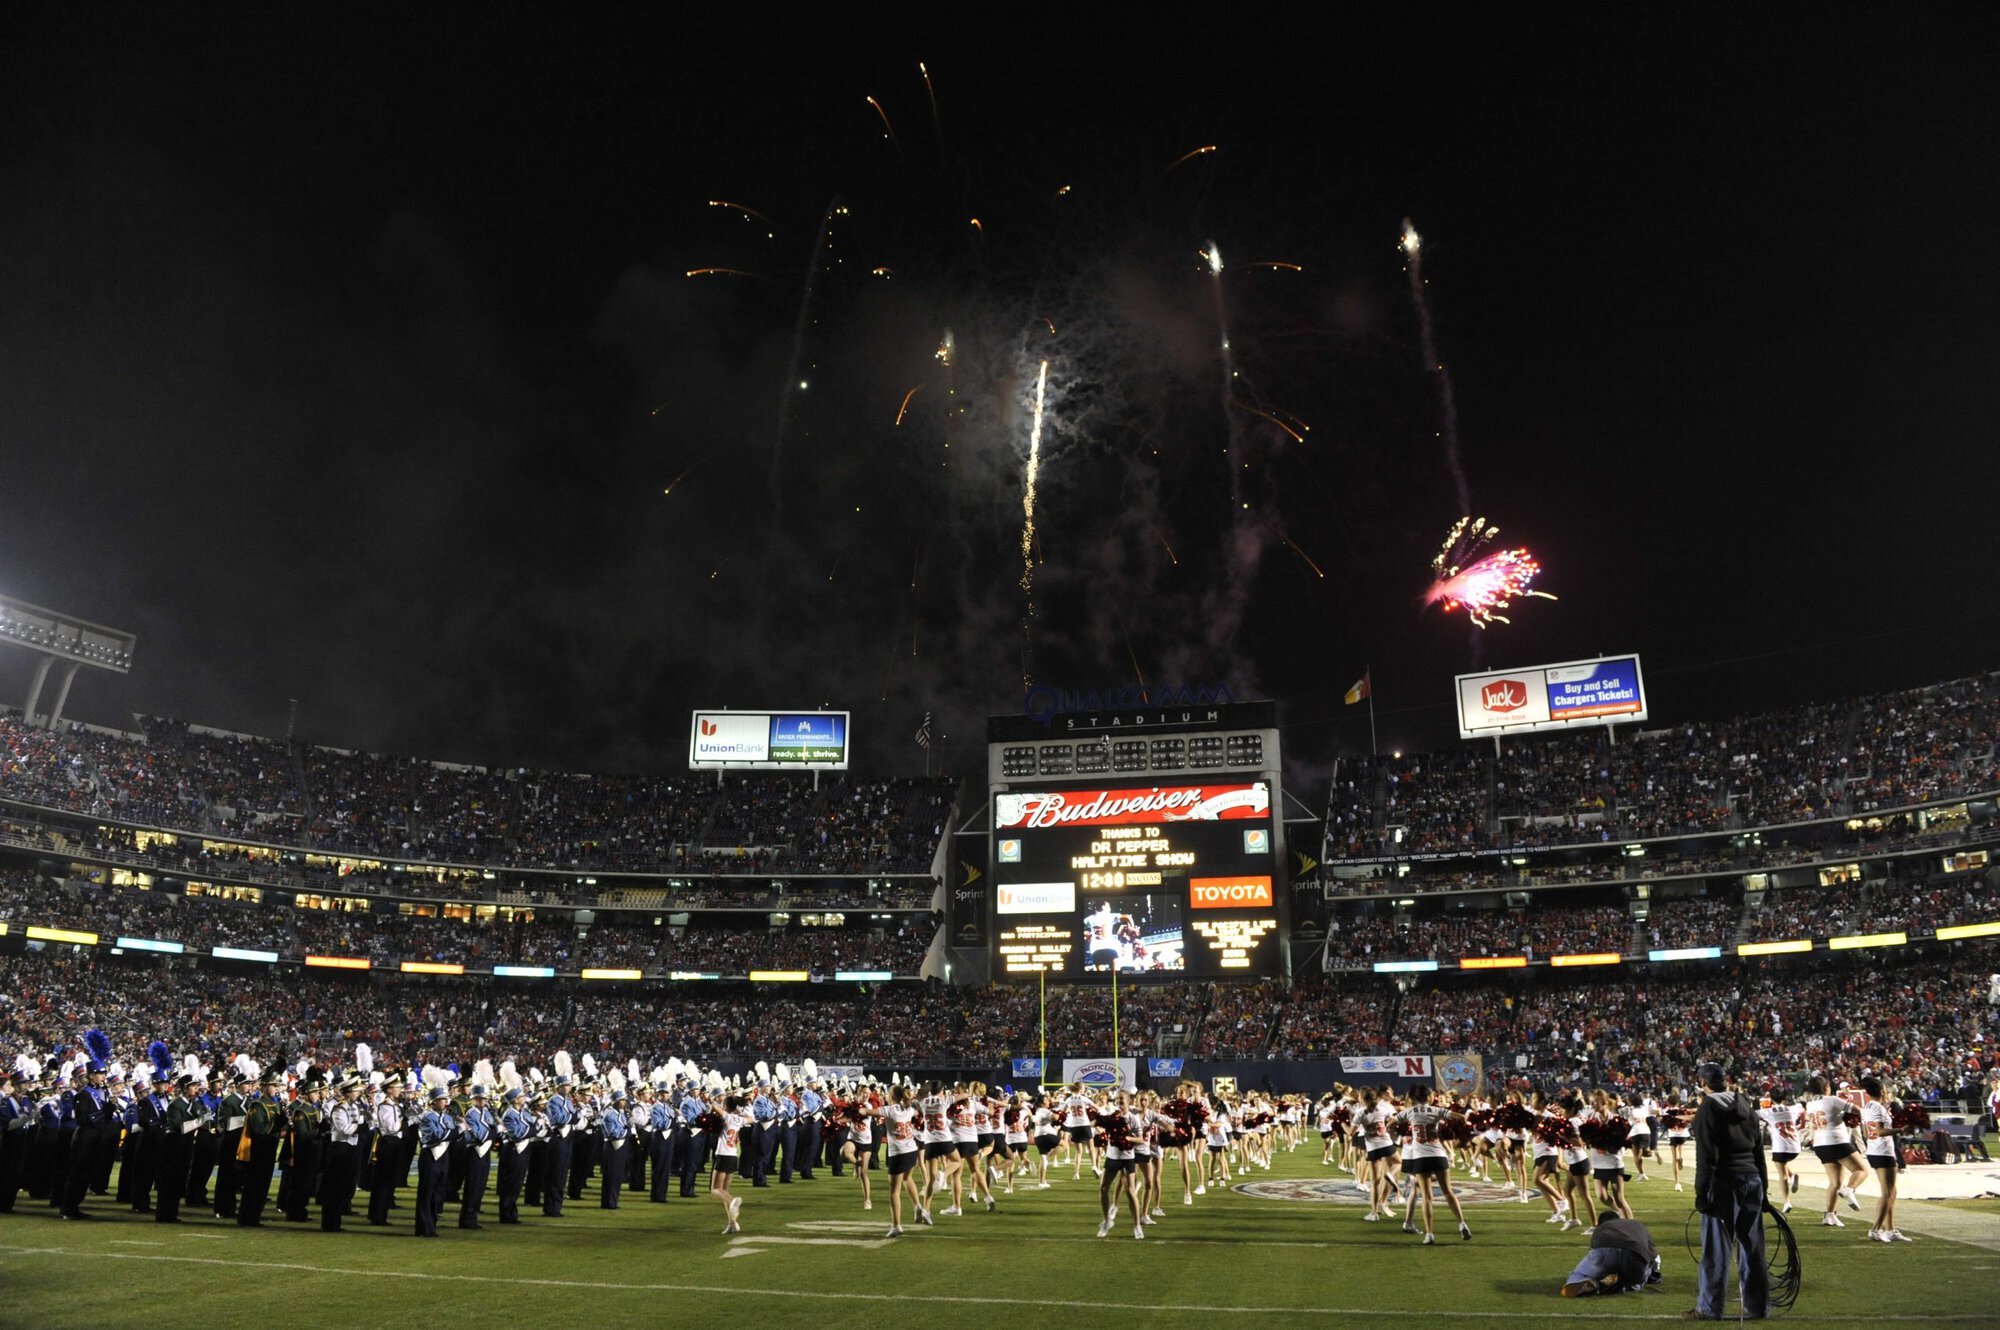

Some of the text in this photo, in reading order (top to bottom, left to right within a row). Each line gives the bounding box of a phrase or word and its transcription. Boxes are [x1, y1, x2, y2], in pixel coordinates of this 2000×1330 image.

[1565, 679, 1620, 694] Buy and Sell
[1484, 683, 1525, 709] Jack
[1554, 688, 1634, 706] Chargers Tickets!
[1023, 682, 1233, 727] QUALCOMM
[1067, 711, 1218, 728] STADIUM
[700, 743, 764, 753] UnionBank
[813, 750, 840, 758] thrive.
[1022, 788, 1202, 828] Budweiser
[1101, 827, 1160, 839] THANKS TO
[1091, 839, 1169, 853] DR PEPPER
[1072, 852, 1195, 868] HALFTIME SHOW
[1290, 879, 1321, 890] Sprint
[955, 889, 984, 901] Sprint
[1194, 885, 1268, 901] TOYOTA
[1080, 1064, 1104, 1075] PACIFIC
[1405, 1058, 1424, 1075] N
[1216, 1078, 1235, 1092] 25
